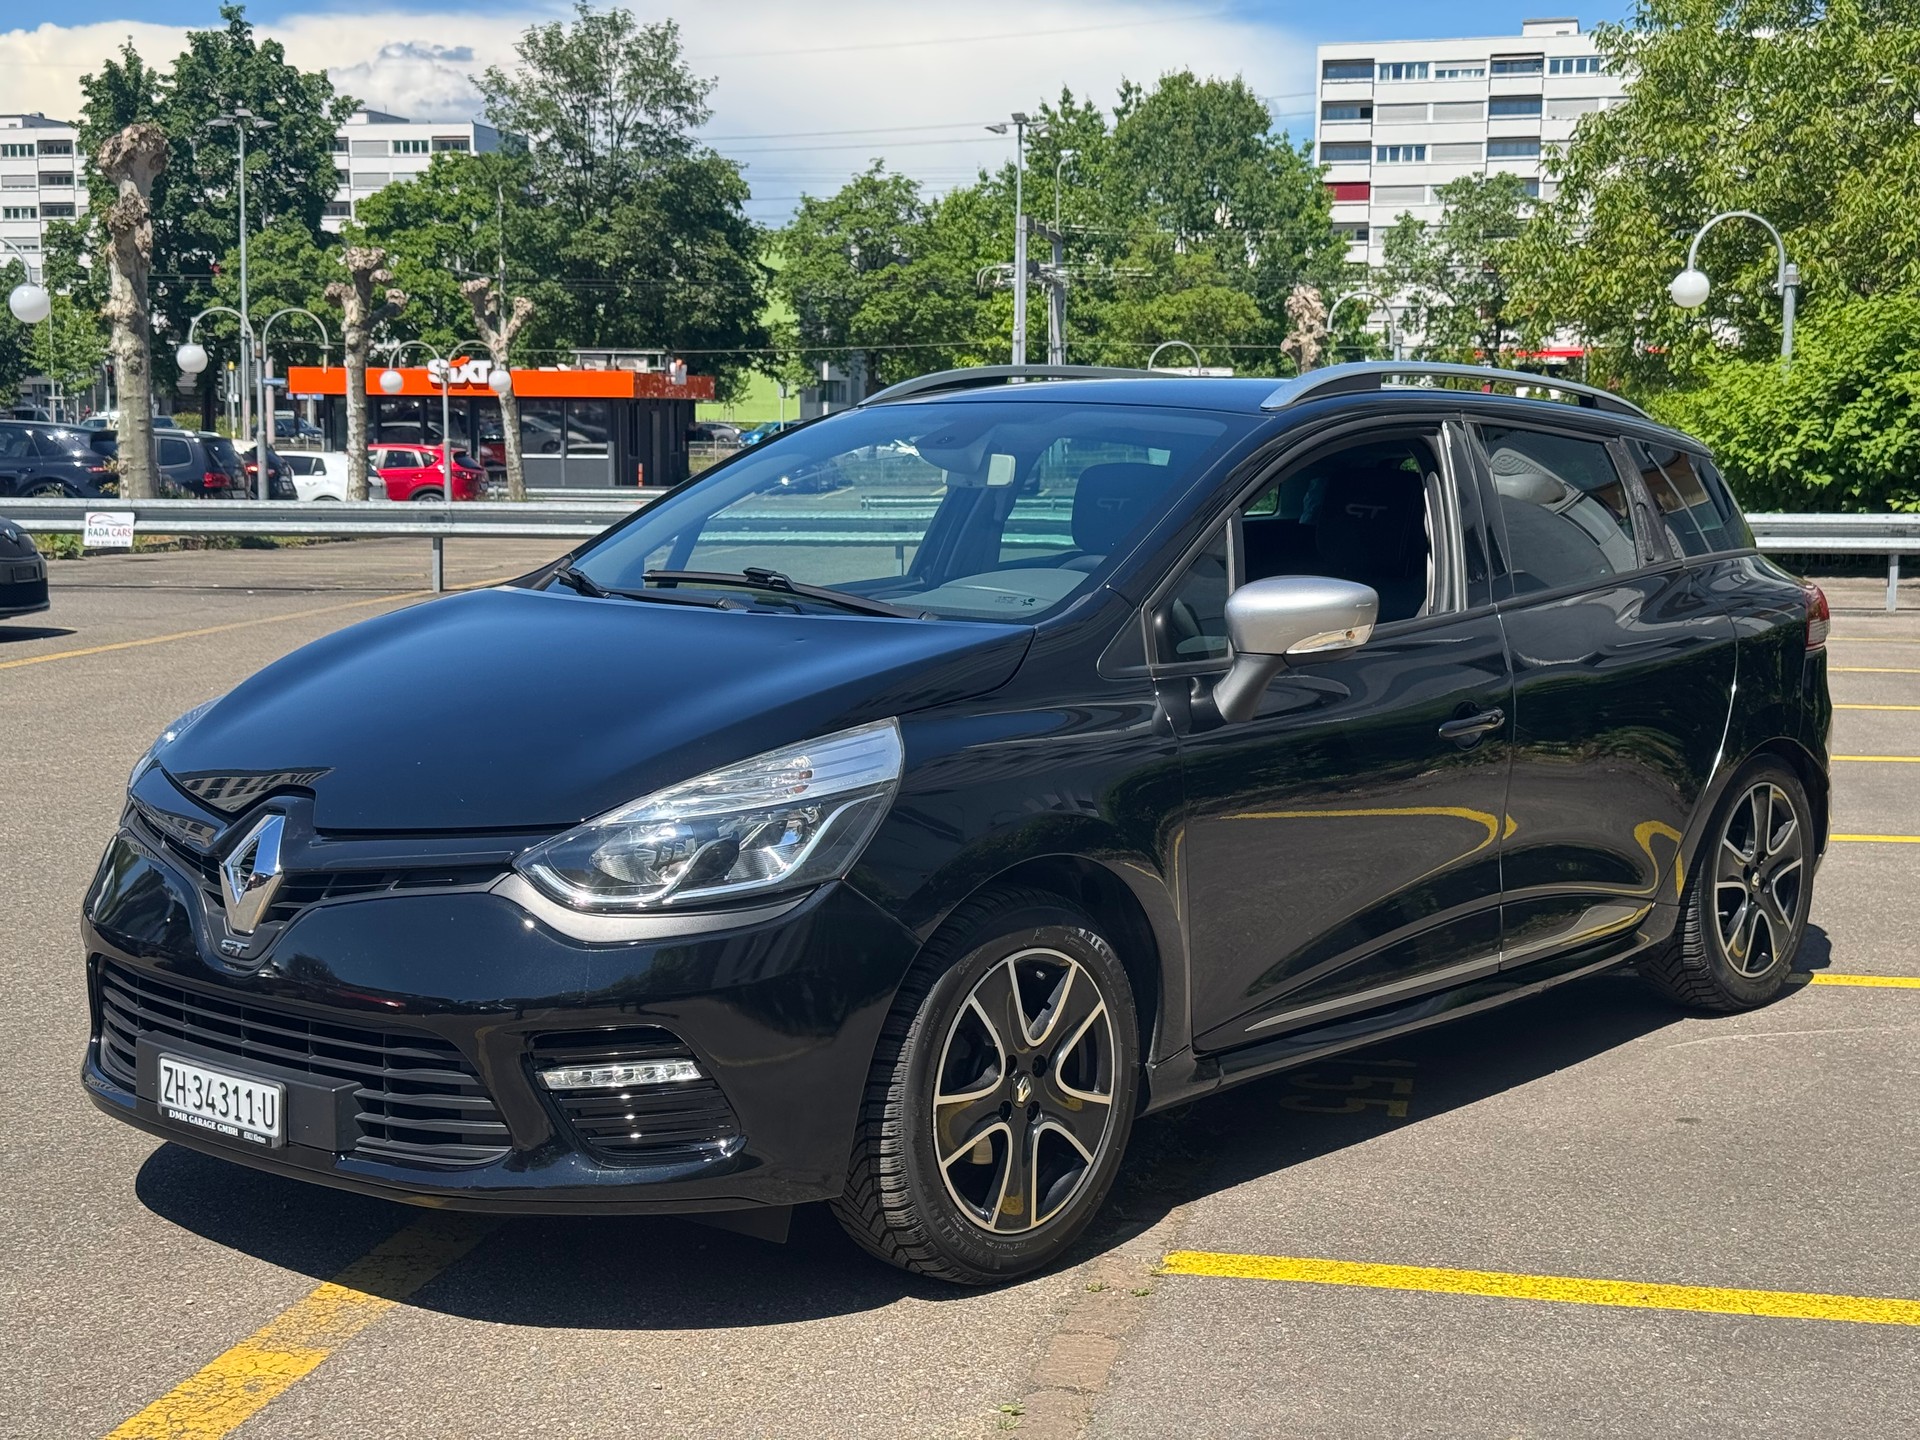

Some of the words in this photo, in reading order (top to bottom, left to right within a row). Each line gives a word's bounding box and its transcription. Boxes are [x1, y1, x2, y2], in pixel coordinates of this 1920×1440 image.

[427, 356, 493, 384] SIXT
[1345, 503, 1388, 519] GT
[88, 528, 110, 537] RADA
[111, 528, 132, 537] CARS
[221, 939, 250, 957] GT
[168, 1109, 188, 1123] DMR
[188, 1113, 216, 1131] GARAGE
